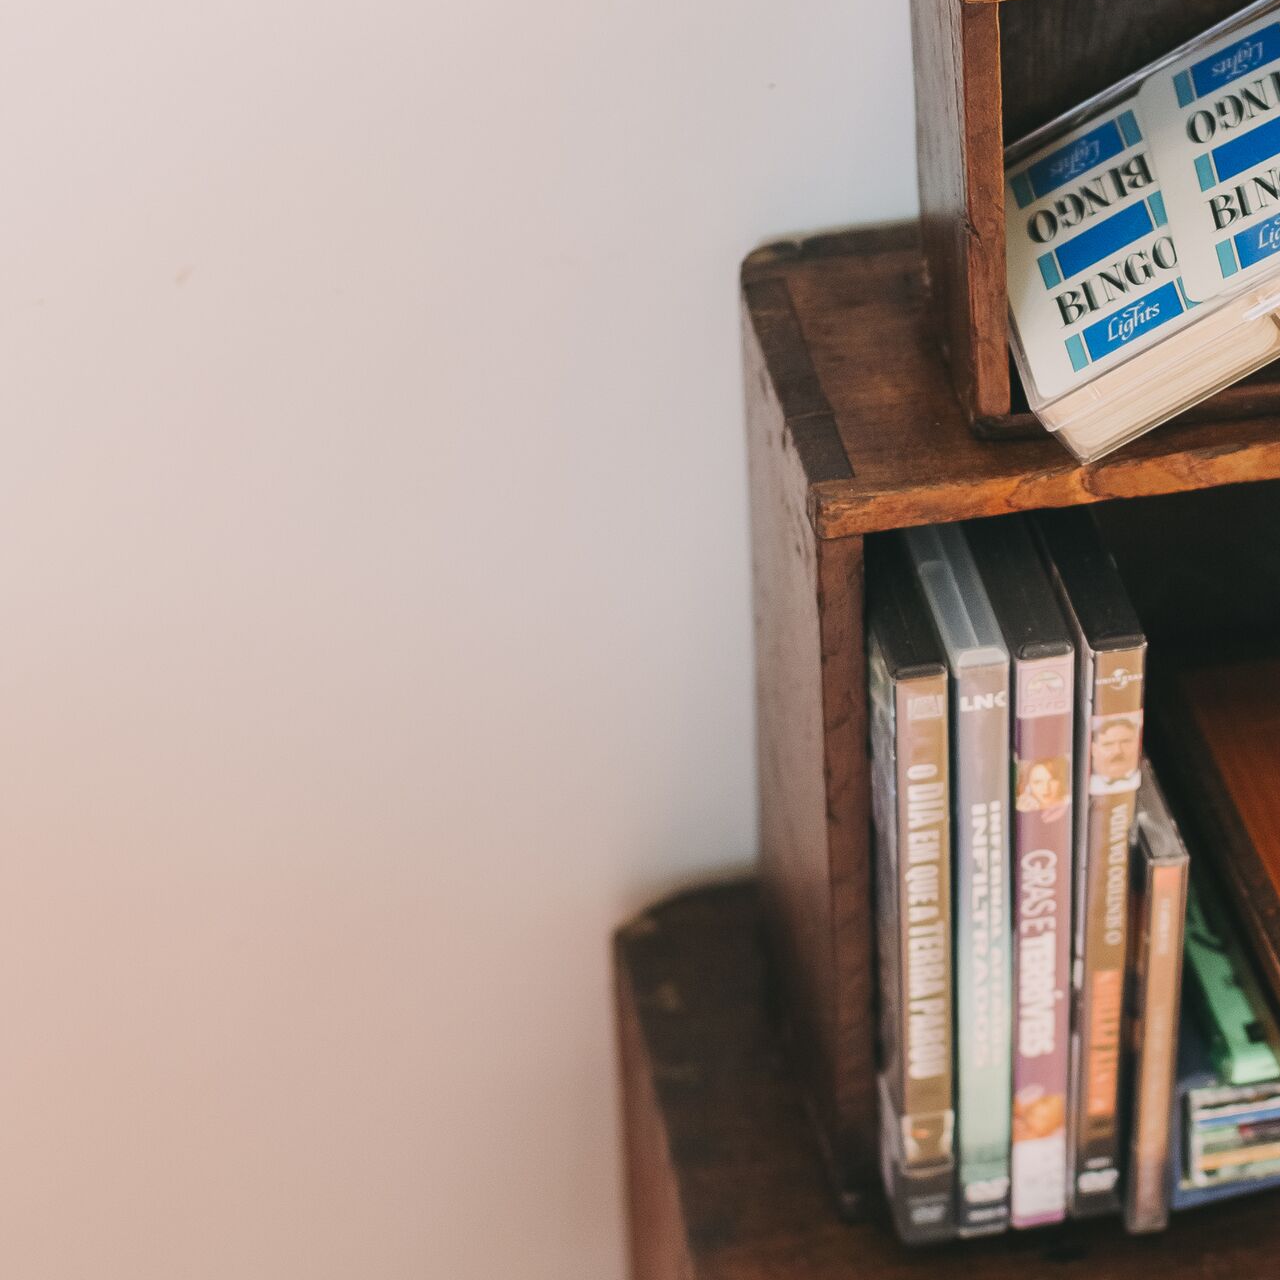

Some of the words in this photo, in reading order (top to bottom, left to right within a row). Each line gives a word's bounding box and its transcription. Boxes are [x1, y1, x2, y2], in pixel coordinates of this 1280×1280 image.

[1211, 40, 1264, 80] Lights
[1026, 154, 1155, 244] BINGO
[1053, 235, 1180, 328] BINGO
[1106, 300, 1161, 342] Lights
[907, 763, 938, 779] O
[908, 783, 945, 828] DIA
[1109, 803, 1128, 842] VIDA
[908, 831, 939, 864] EM
[907, 865, 939, 904] QUE
[972, 804, 989, 1066] INFILTRADOS
[1020, 917, 1055, 934] E
[909, 923, 945, 998] TERRA
[909, 999, 945, 1079] PAROU
